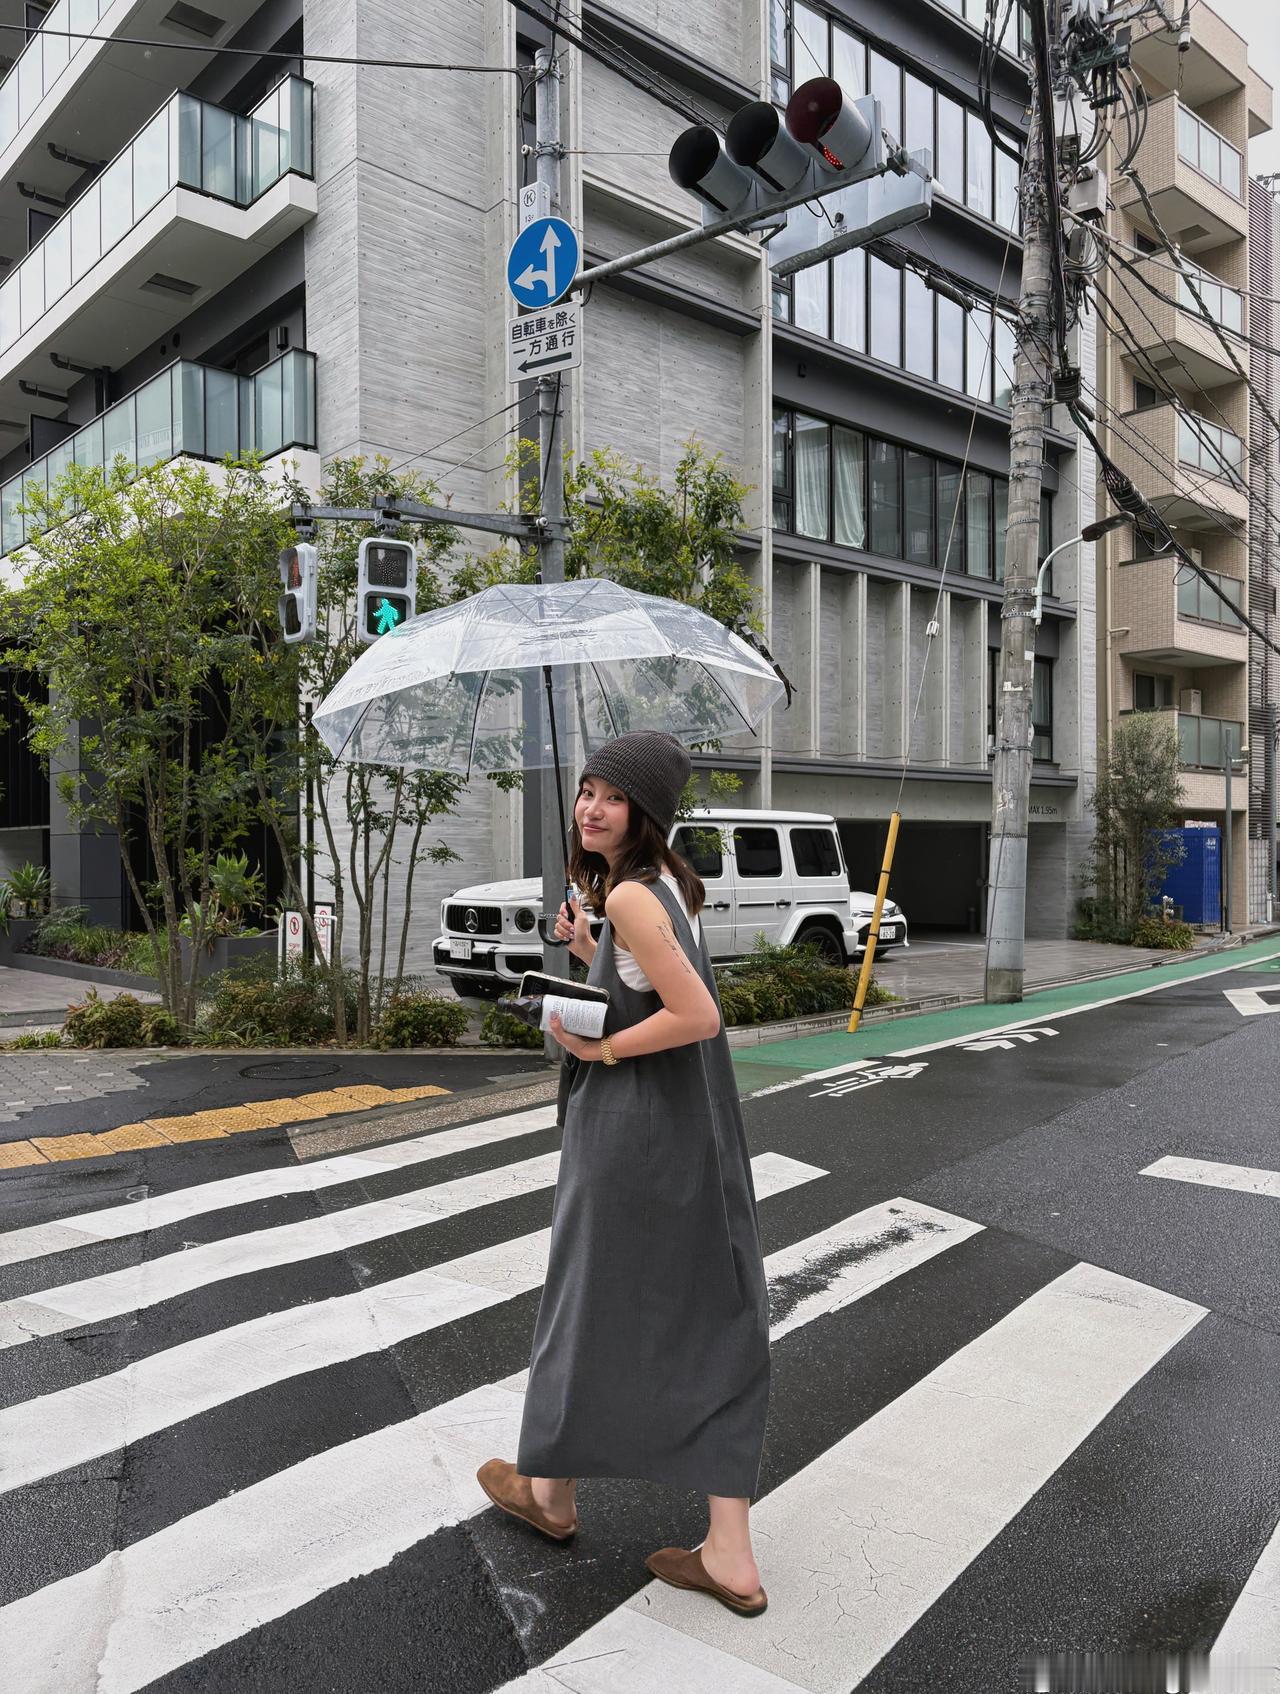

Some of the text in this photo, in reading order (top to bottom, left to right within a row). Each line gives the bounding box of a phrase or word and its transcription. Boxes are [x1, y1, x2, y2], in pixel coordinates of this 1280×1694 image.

[512, 311, 576, 340] 自転車を除く
[513, 330, 575, 356] 一方通行
